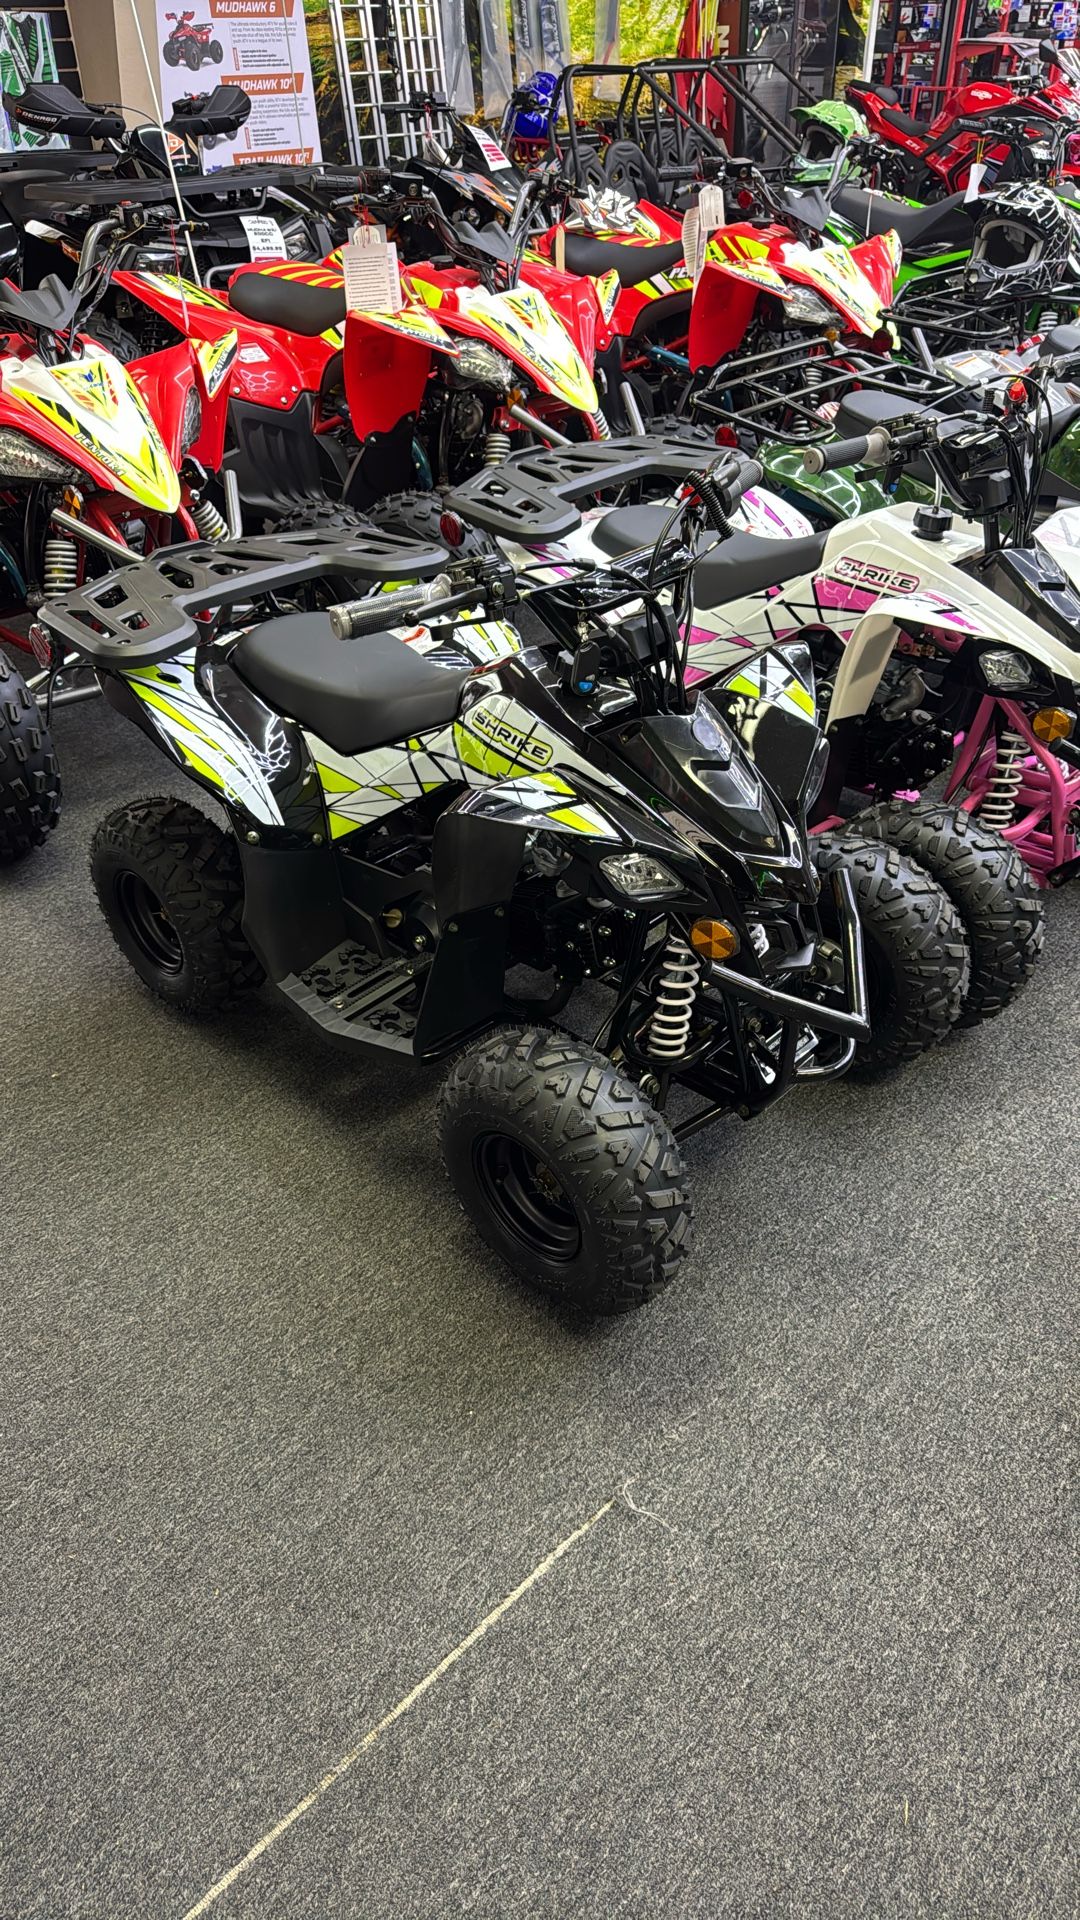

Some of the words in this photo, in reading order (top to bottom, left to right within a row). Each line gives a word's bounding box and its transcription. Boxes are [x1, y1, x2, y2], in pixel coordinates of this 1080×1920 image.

[216, 1, 267, 13] MUDHAWK
[269, 1, 276, 13] 6
[22, 111, 57, 123] DENAGO
[74, 432, 127, 477] PENTORA
[840, 561, 916, 591] SHRIKE
[474, 711, 549, 760] SHRIKE
